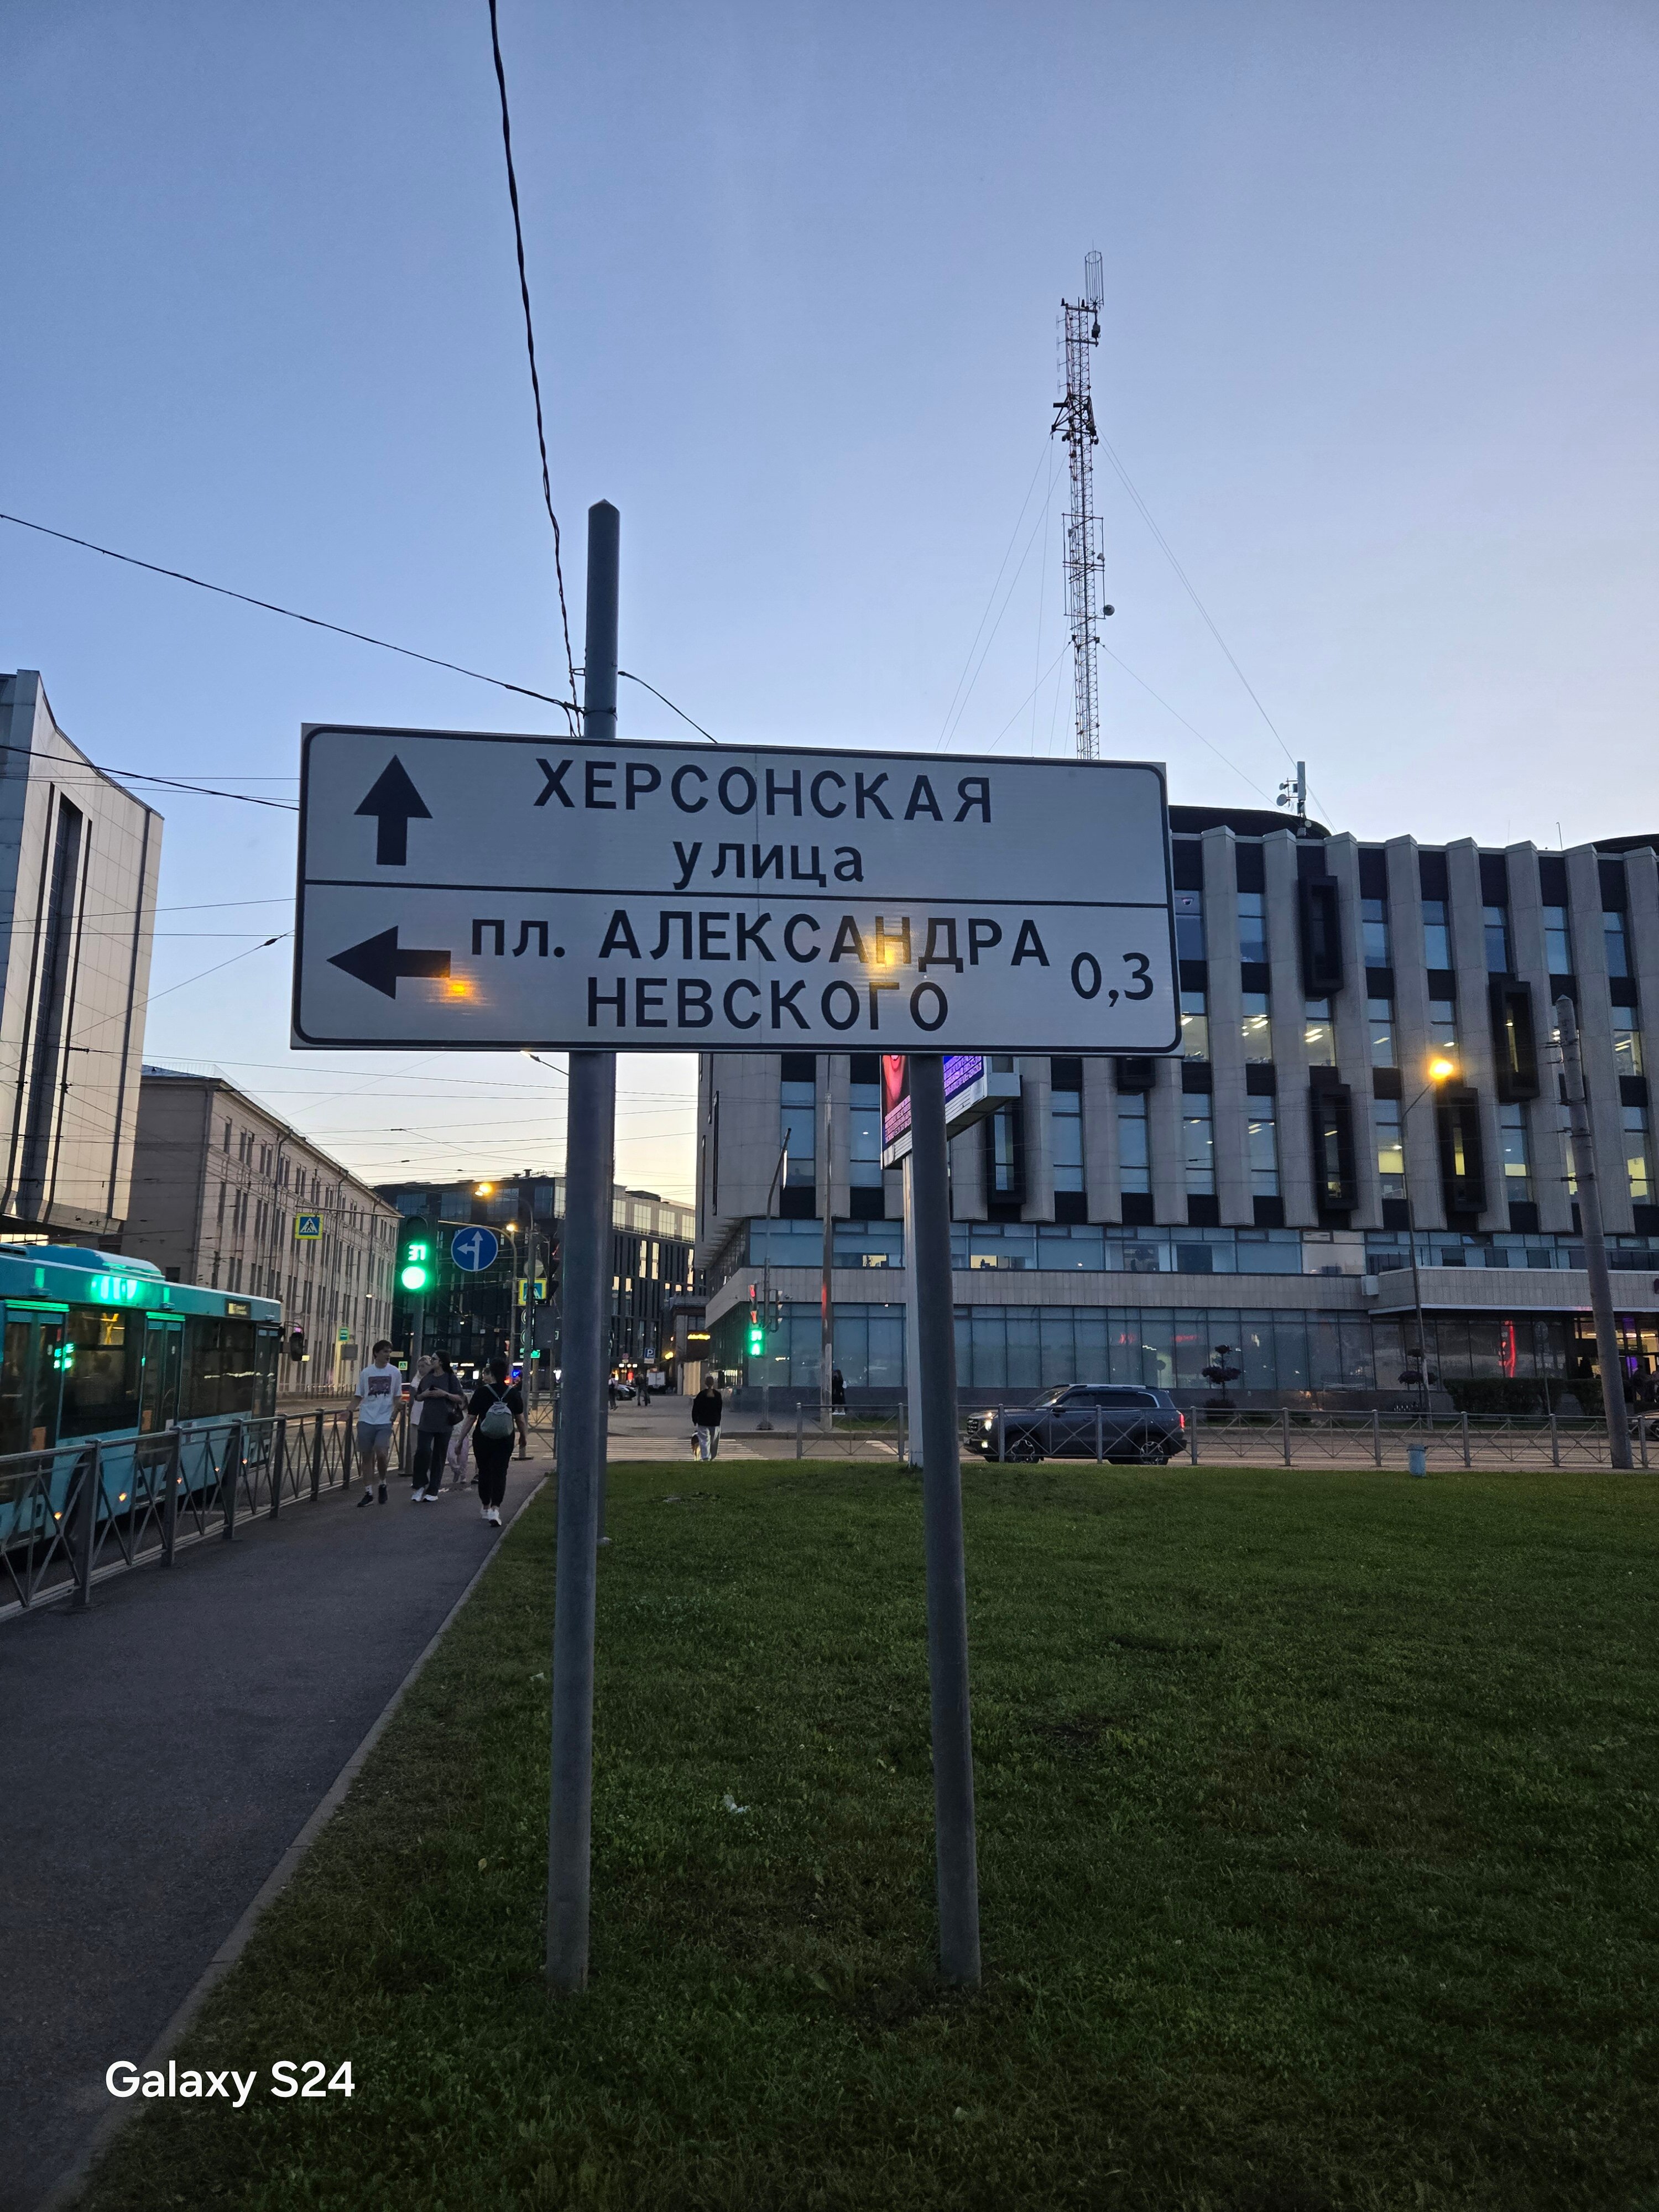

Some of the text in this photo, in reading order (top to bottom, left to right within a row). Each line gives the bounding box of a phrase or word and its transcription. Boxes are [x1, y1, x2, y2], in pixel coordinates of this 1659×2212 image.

[533, 758, 992, 823] ХЕРСОНСКАЯ
[672, 841, 864, 890] улица
[471, 909, 1051, 974] пл. АЛЕКСАНДРА
[588, 977, 949, 1032] НЕВСКОГО
[1071, 952, 1154, 1008] 0,3
